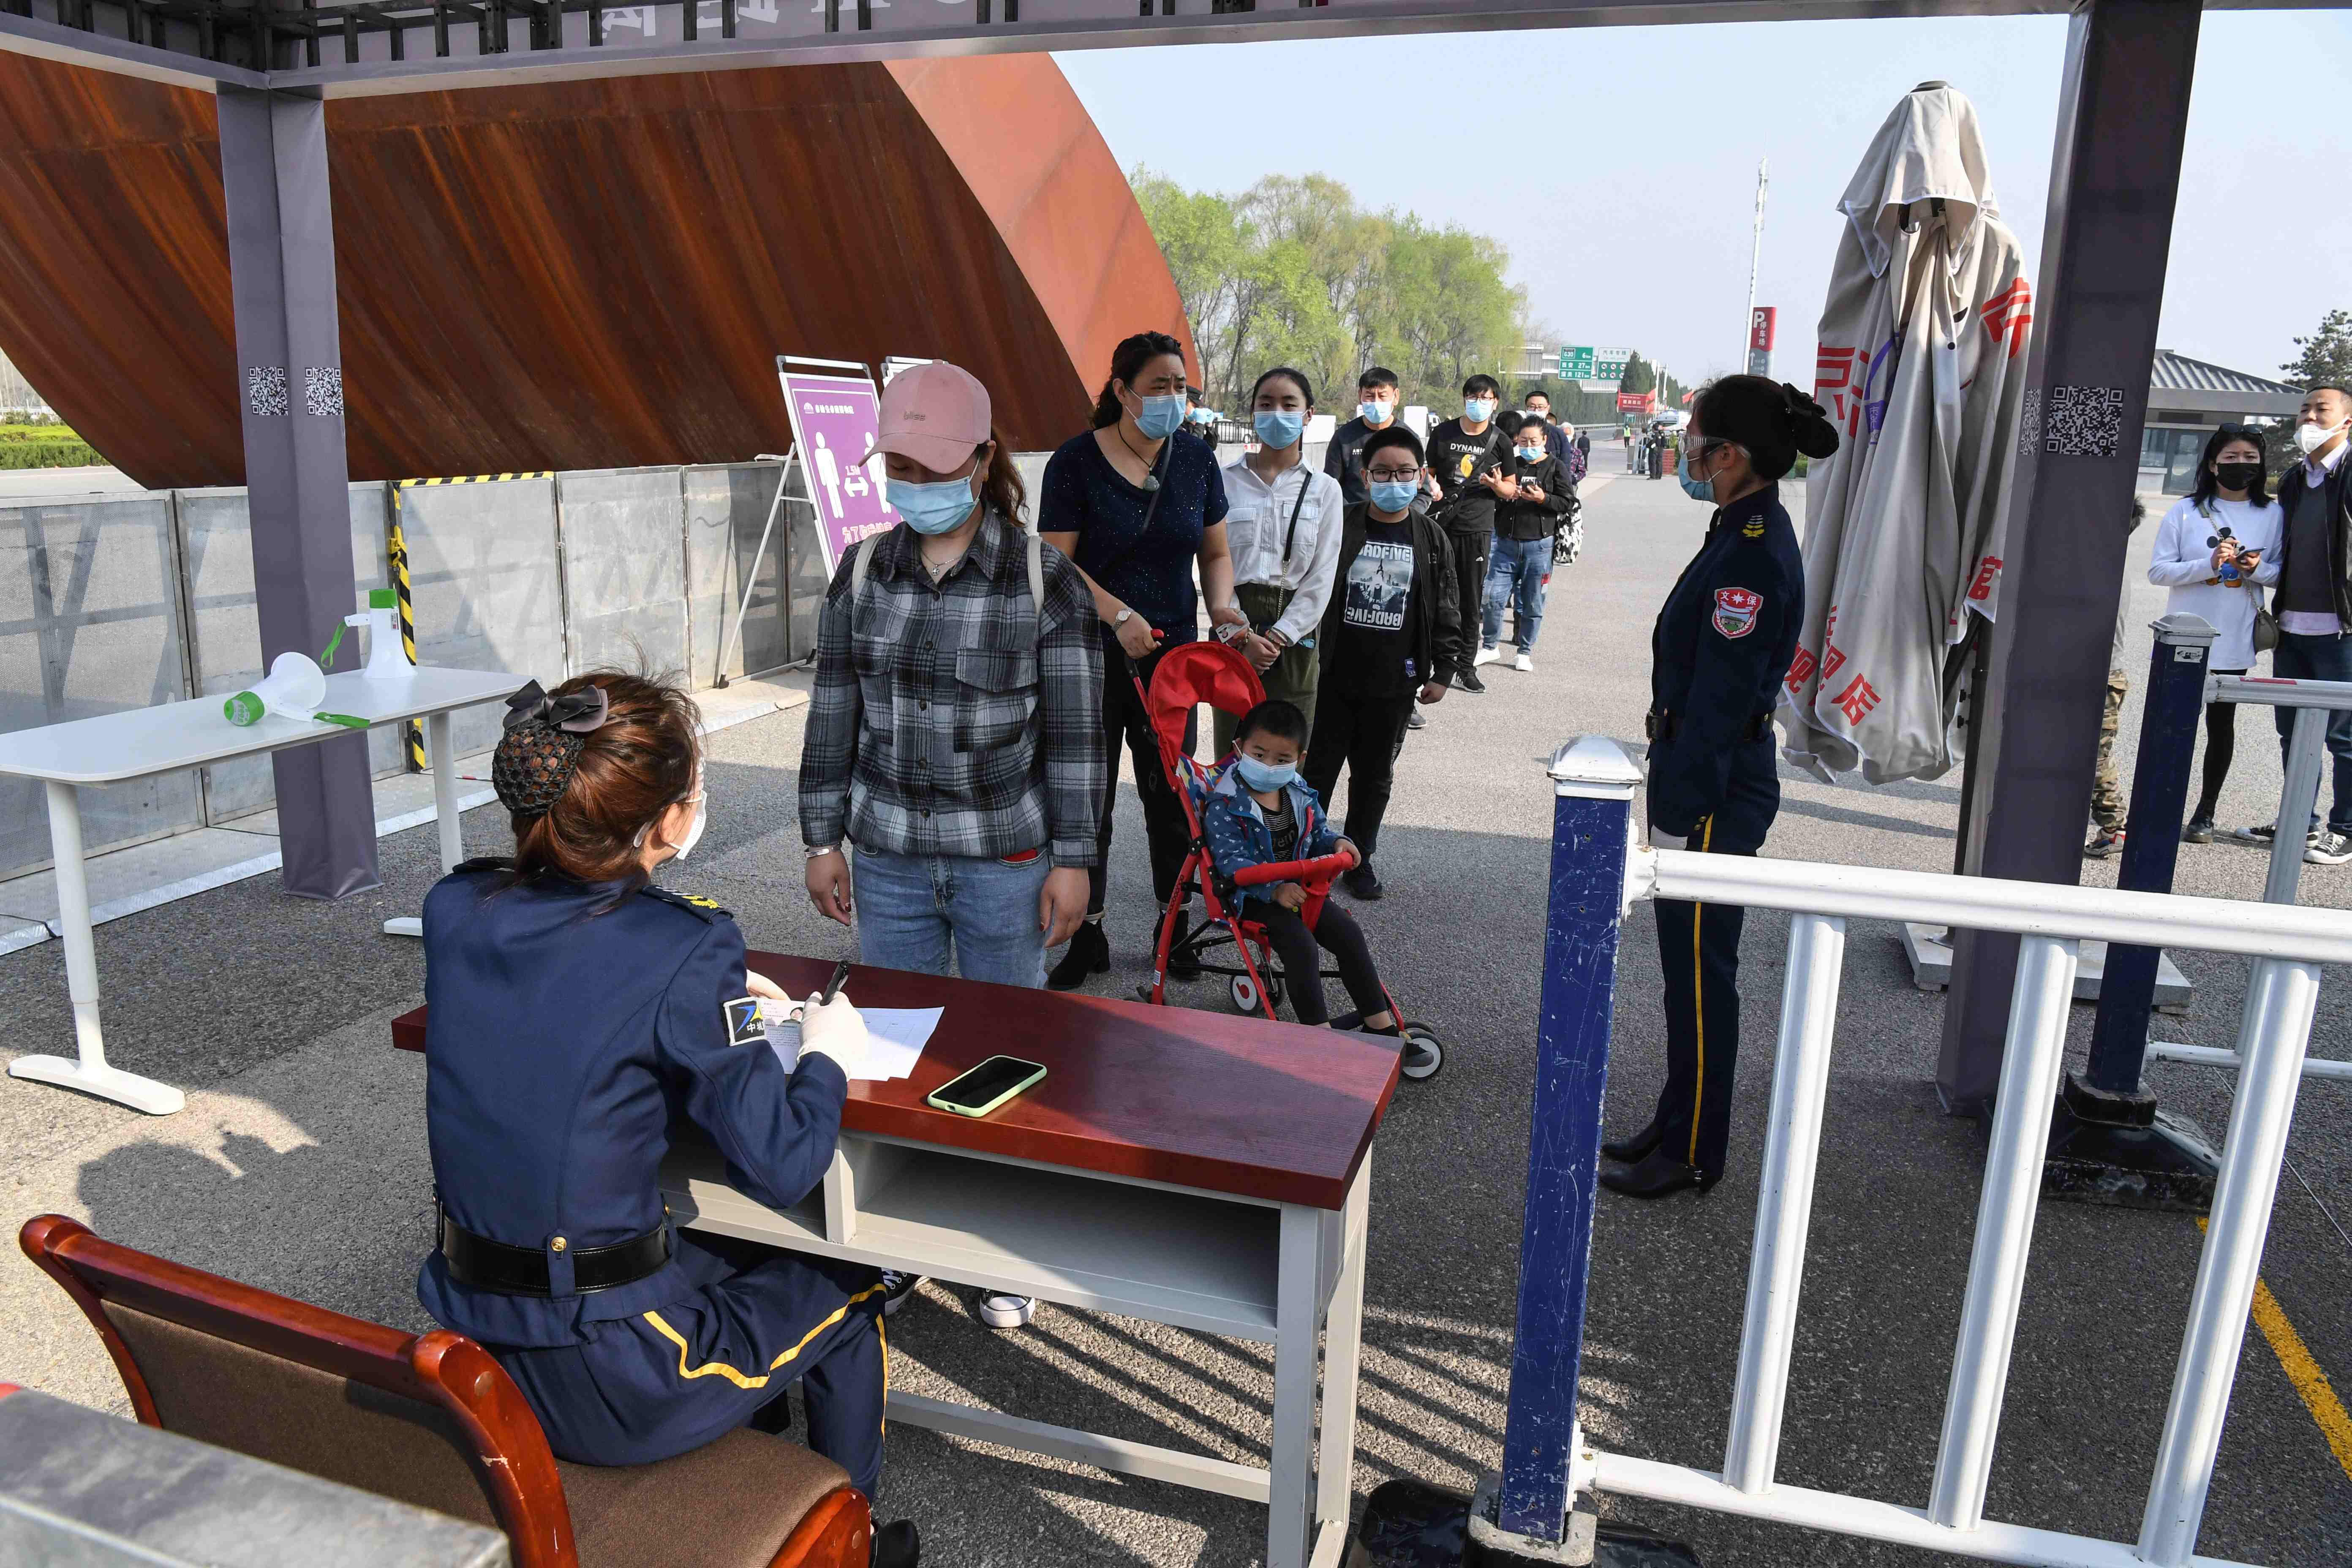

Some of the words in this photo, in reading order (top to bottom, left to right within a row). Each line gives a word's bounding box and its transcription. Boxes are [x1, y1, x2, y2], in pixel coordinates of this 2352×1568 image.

[1753, 311, 1764, 328] P
[1758, 321, 1767, 346] 停车场
[1720, 591, 1730, 601] 文
[1747, 595, 1756, 606] 保
